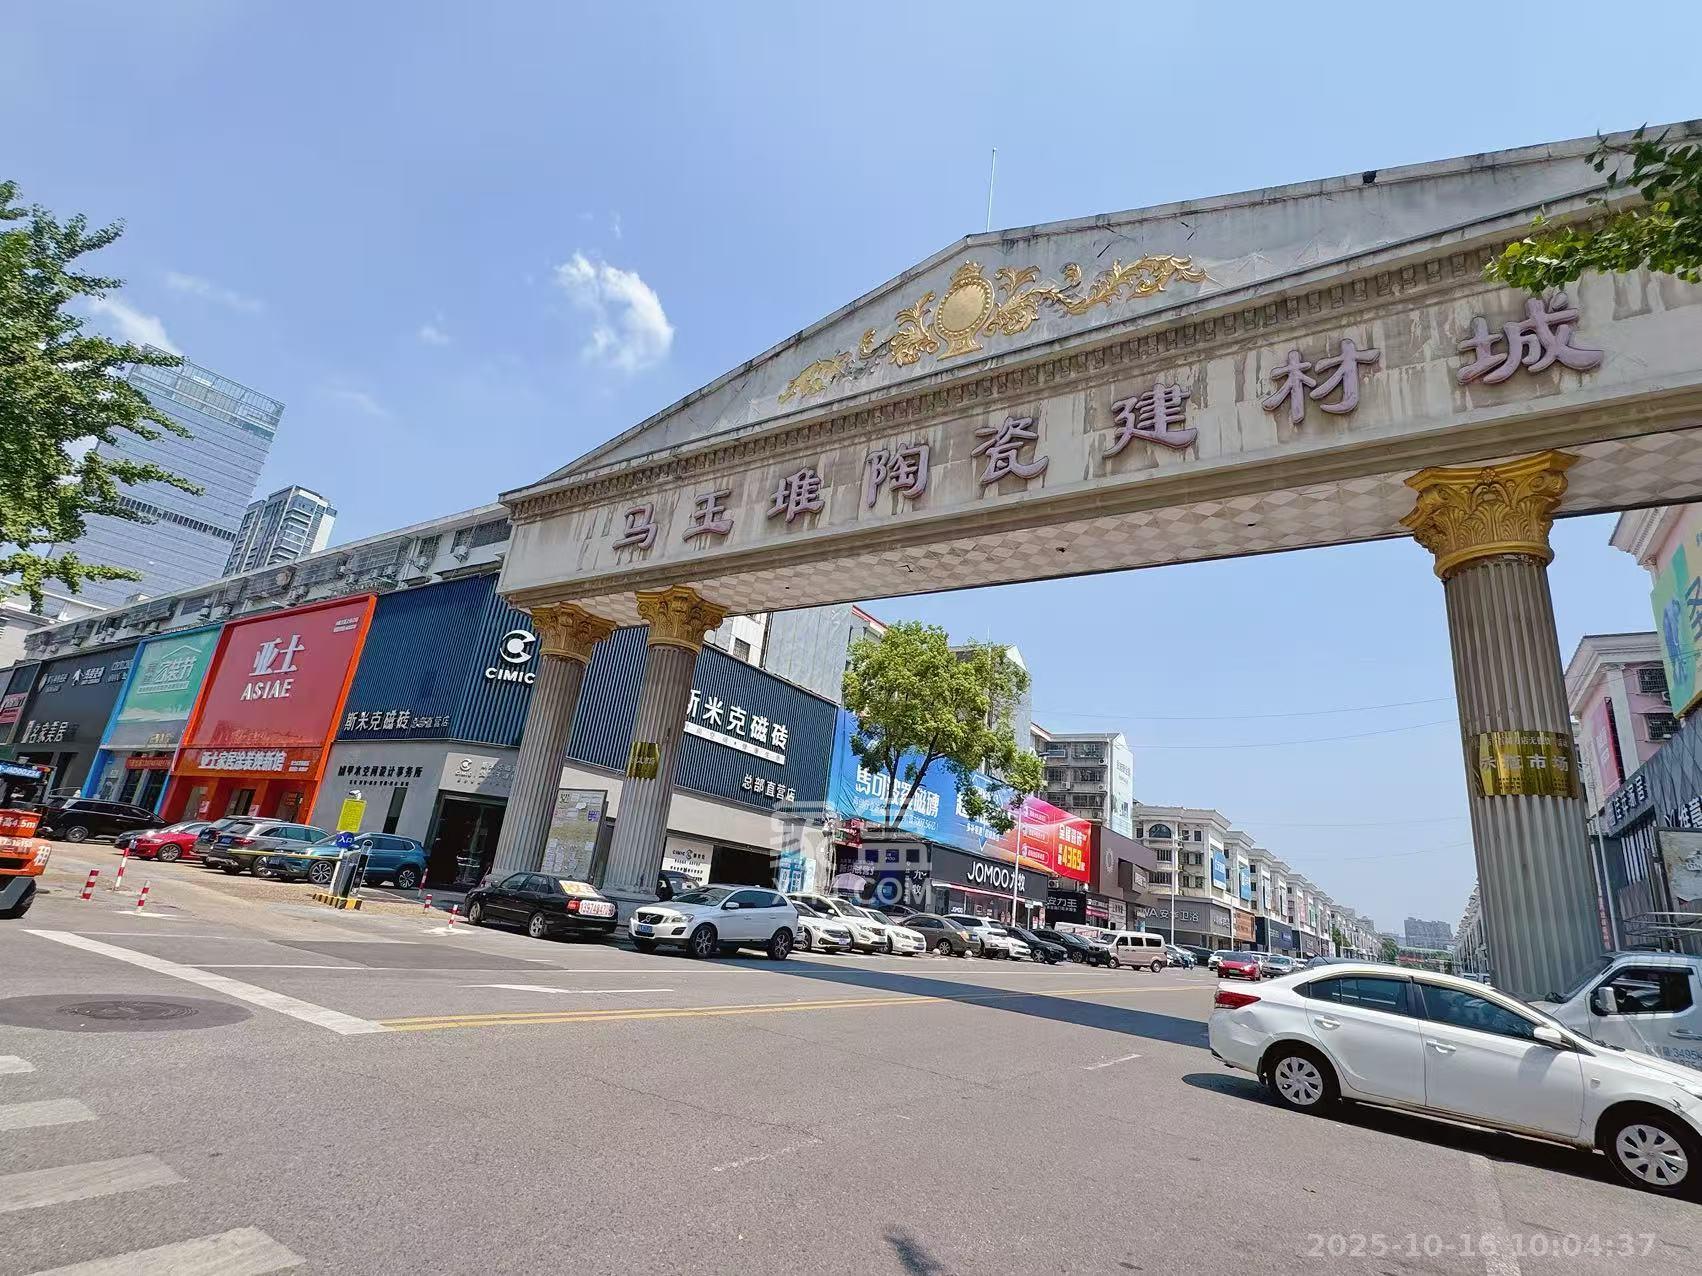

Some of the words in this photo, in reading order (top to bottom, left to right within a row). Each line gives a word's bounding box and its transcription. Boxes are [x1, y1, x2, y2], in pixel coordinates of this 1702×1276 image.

[249, 634, 305, 676] 亚士
[485, 667, 537, 684] CIMIC
[240, 679, 294, 700] ASIAE
[344, 709, 411, 732] 斯米克磁砖
[742, 773, 796, 802] 总部直营店
[967, 861, 1009, 888] JOMOO
